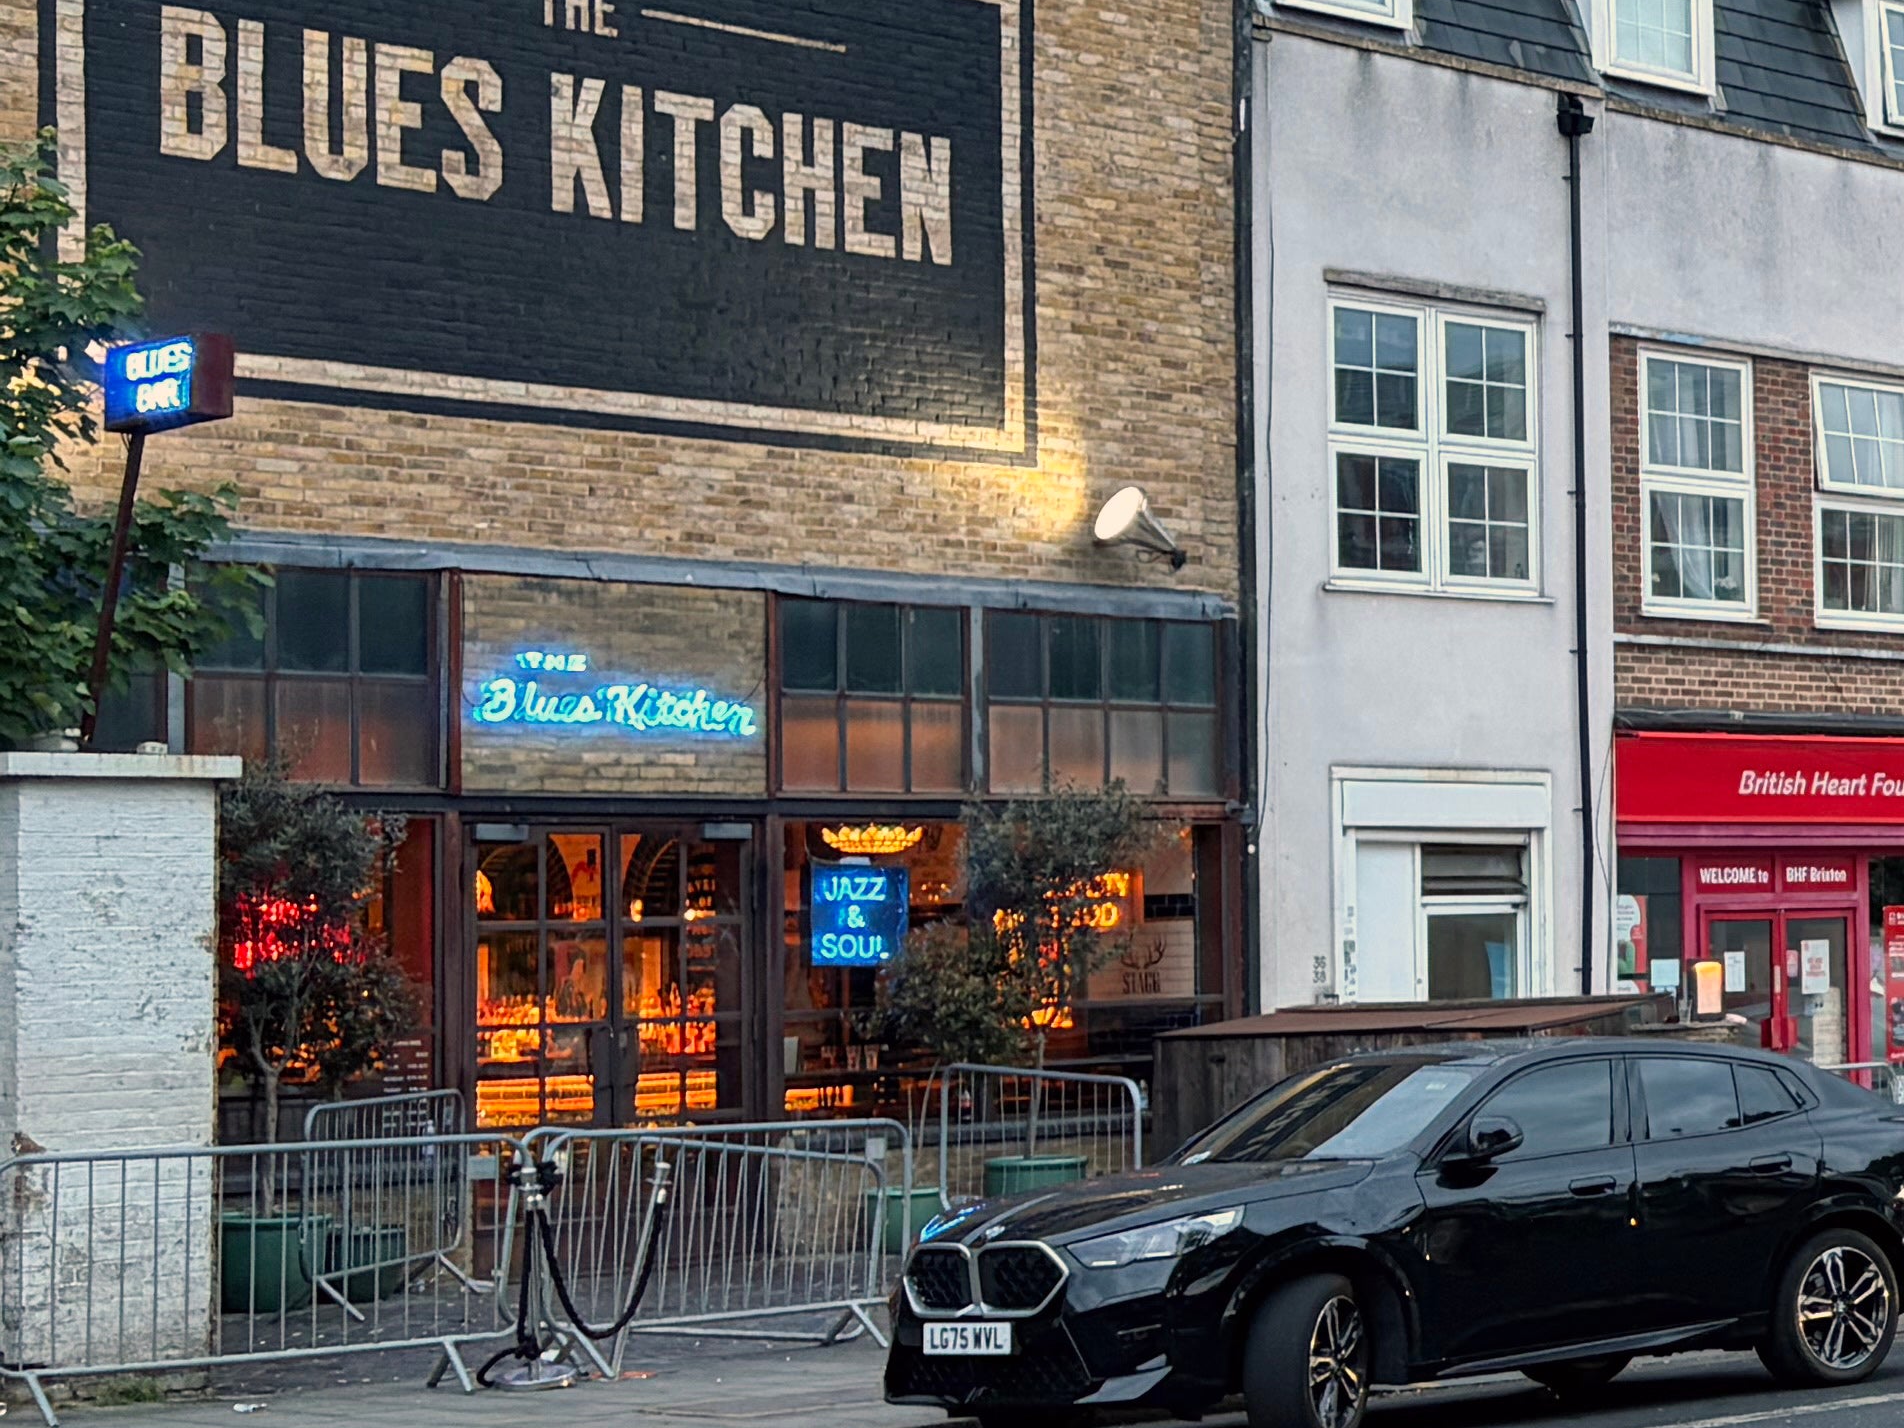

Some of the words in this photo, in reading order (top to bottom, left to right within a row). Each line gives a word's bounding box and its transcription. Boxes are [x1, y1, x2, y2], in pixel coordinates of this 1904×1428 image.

[160, 5, 503, 200] BLUES
[550, 72, 951, 266] KITCHEN
[126, 342, 192, 381] BLUES
[136, 378, 180, 412] BAR
[518, 651, 587, 672] THE
[478, 678, 603, 722] Blues
[604, 684, 756, 735] Kitchen
[1739, 770, 1805, 795] British
[1811, 771, 1866, 796] Heart
[1700, 867, 1756, 883] WELCOME
[1758, 869, 1769, 883] to
[1786, 866, 1808, 882] BHF
[824, 876, 886, 902] JAZZ
[847, 904, 866, 929] &
[929, 1329, 970, 1350] LG75
